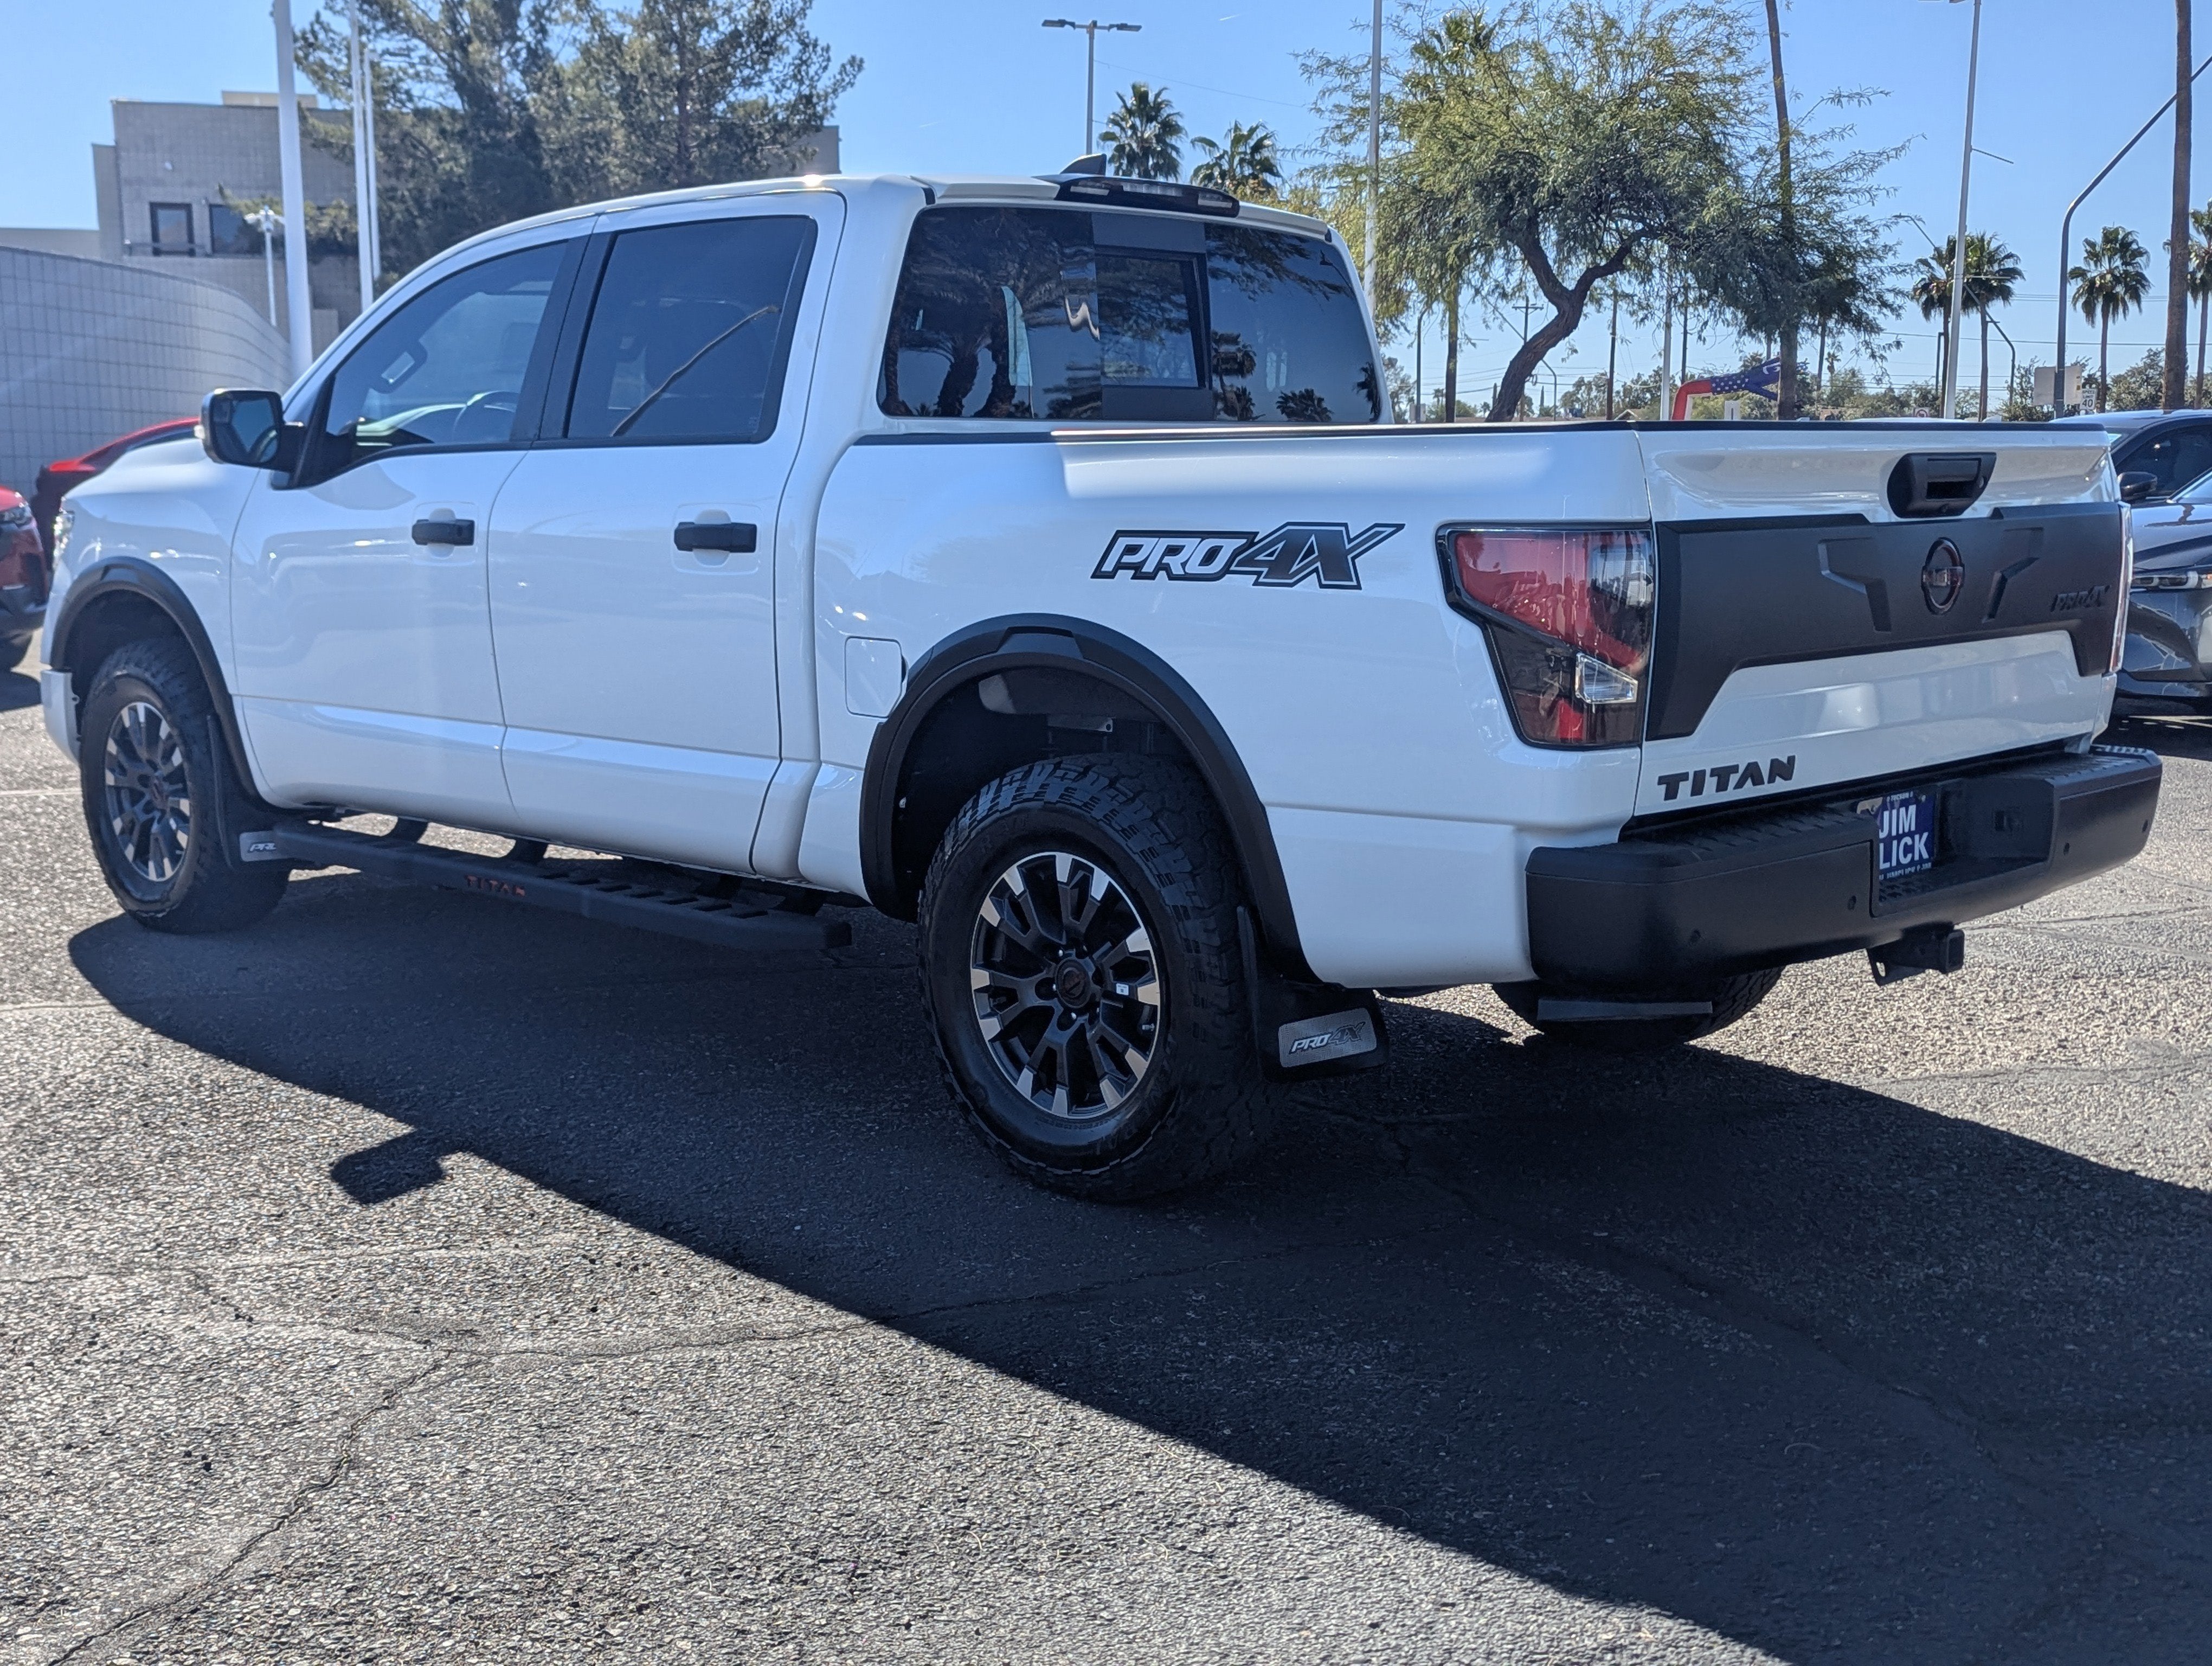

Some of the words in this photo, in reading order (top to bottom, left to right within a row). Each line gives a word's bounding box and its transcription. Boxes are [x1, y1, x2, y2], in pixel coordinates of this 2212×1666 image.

[2082, 399, 2093, 407] 40
[1657, 754, 1796, 802] TITAN
[1879, 804, 1917, 839] JIM
